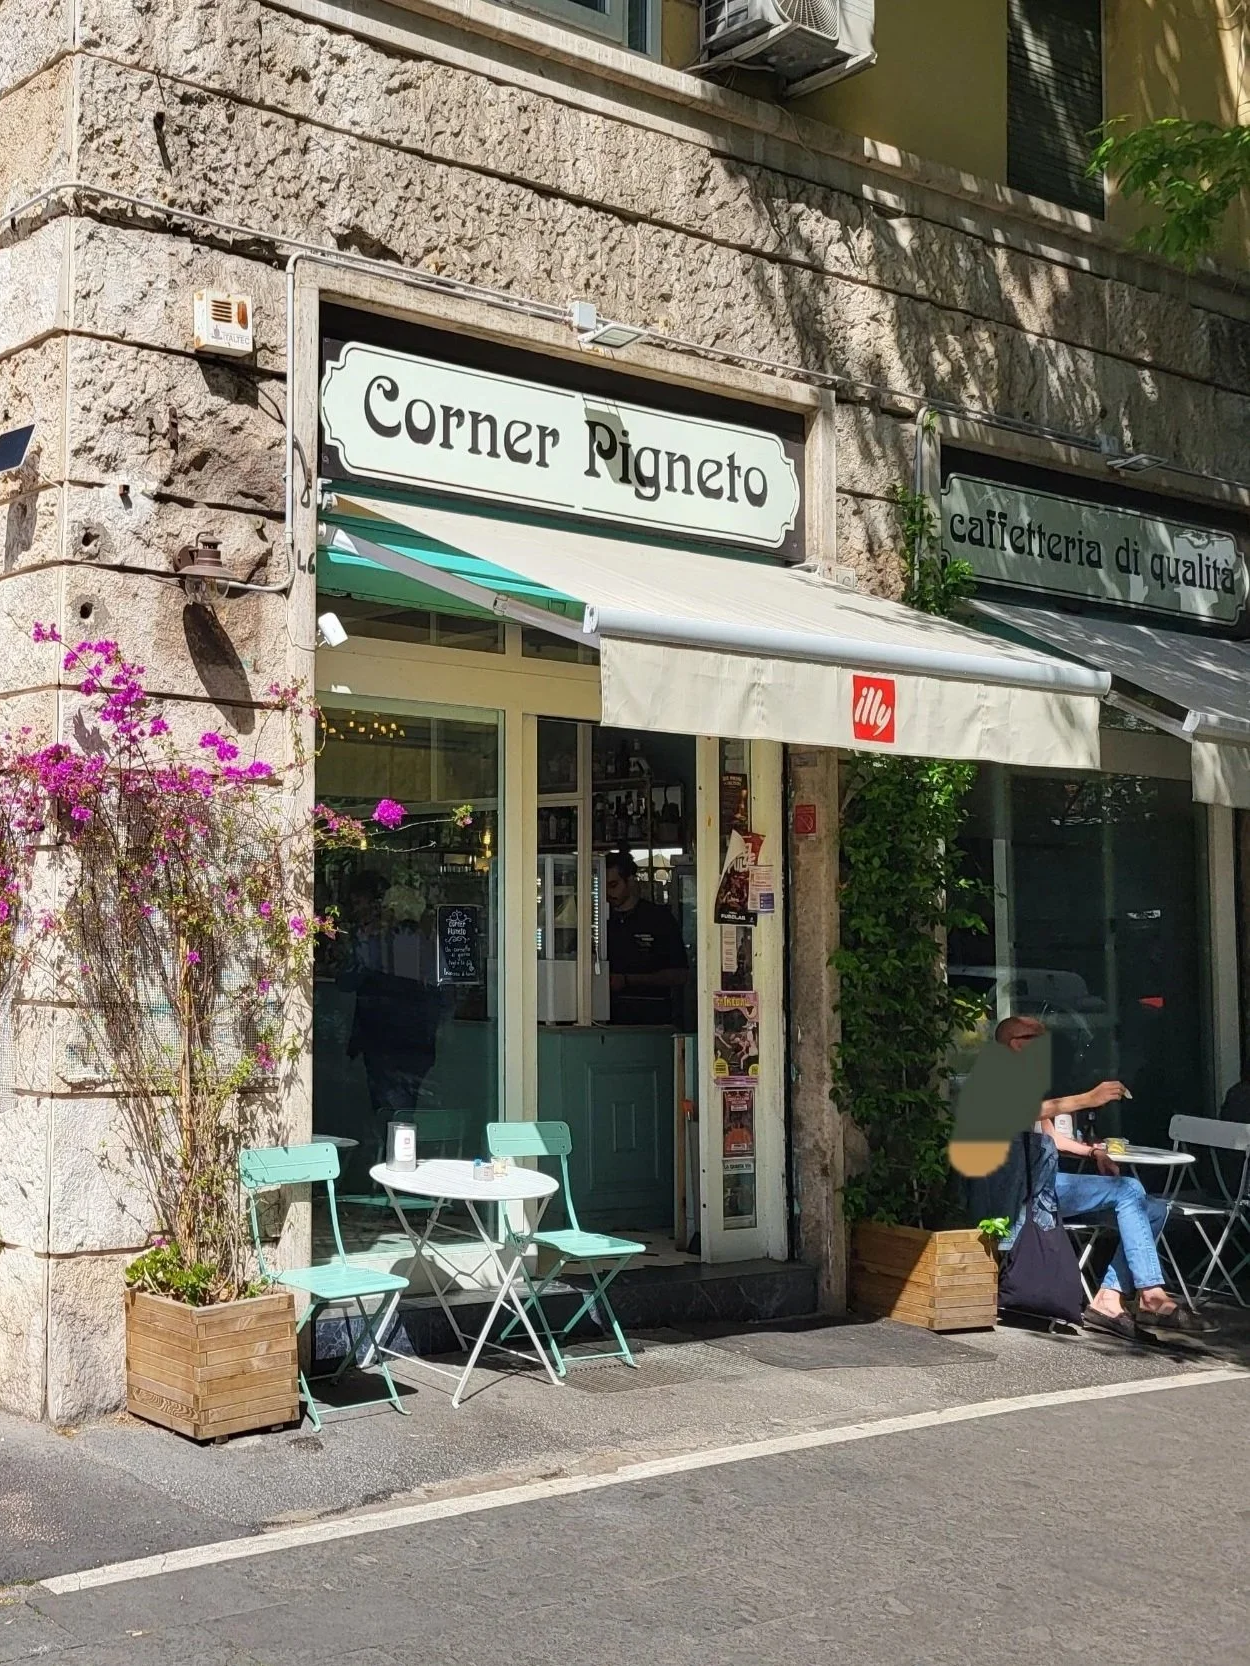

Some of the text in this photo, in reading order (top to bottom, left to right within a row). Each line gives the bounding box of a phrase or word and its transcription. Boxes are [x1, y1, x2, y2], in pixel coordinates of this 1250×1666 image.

[363, 375, 768, 508] Corner Pigneto
[297, 549, 316, 575] 46
[949, 509, 1236, 595] caffetteria di qualità
[854, 686, 892, 737] illy
